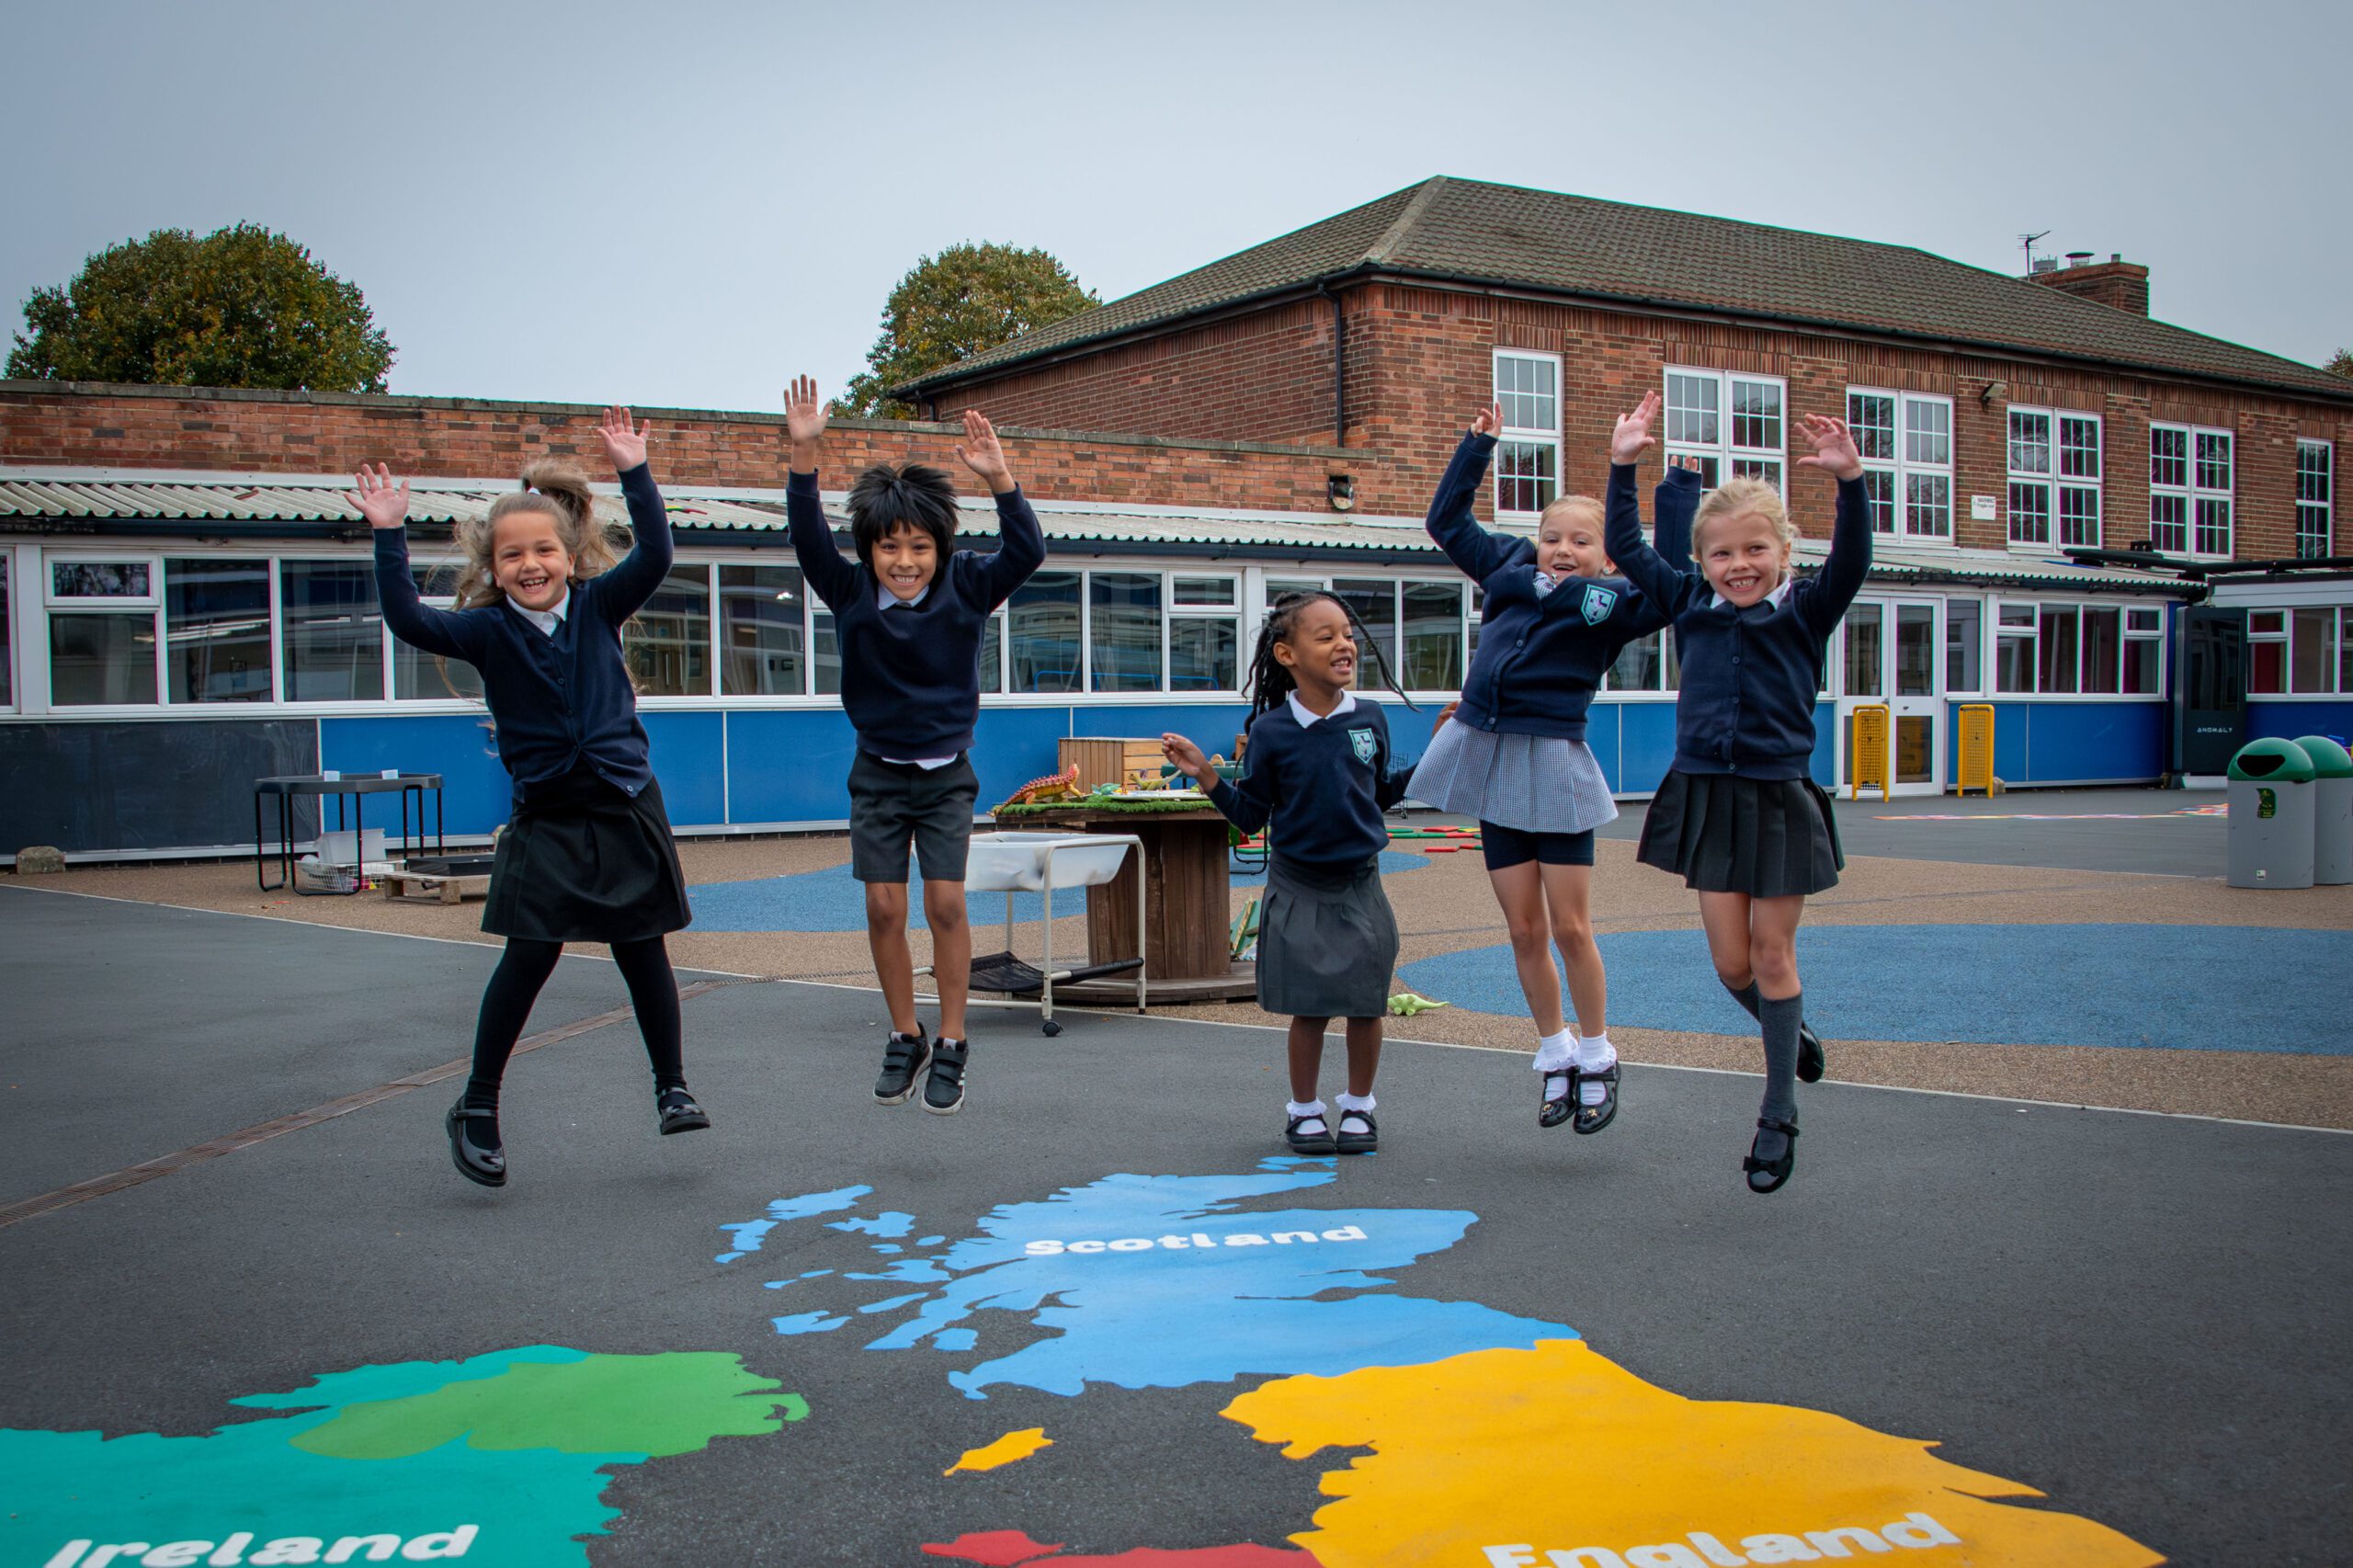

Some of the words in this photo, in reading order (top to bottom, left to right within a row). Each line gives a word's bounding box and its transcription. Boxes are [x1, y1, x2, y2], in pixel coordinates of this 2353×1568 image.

[1025, 1225, 1368, 1256] Scotland
[43, 1524, 480, 1568] Ireland
[1481, 1512, 1961, 1568] England
